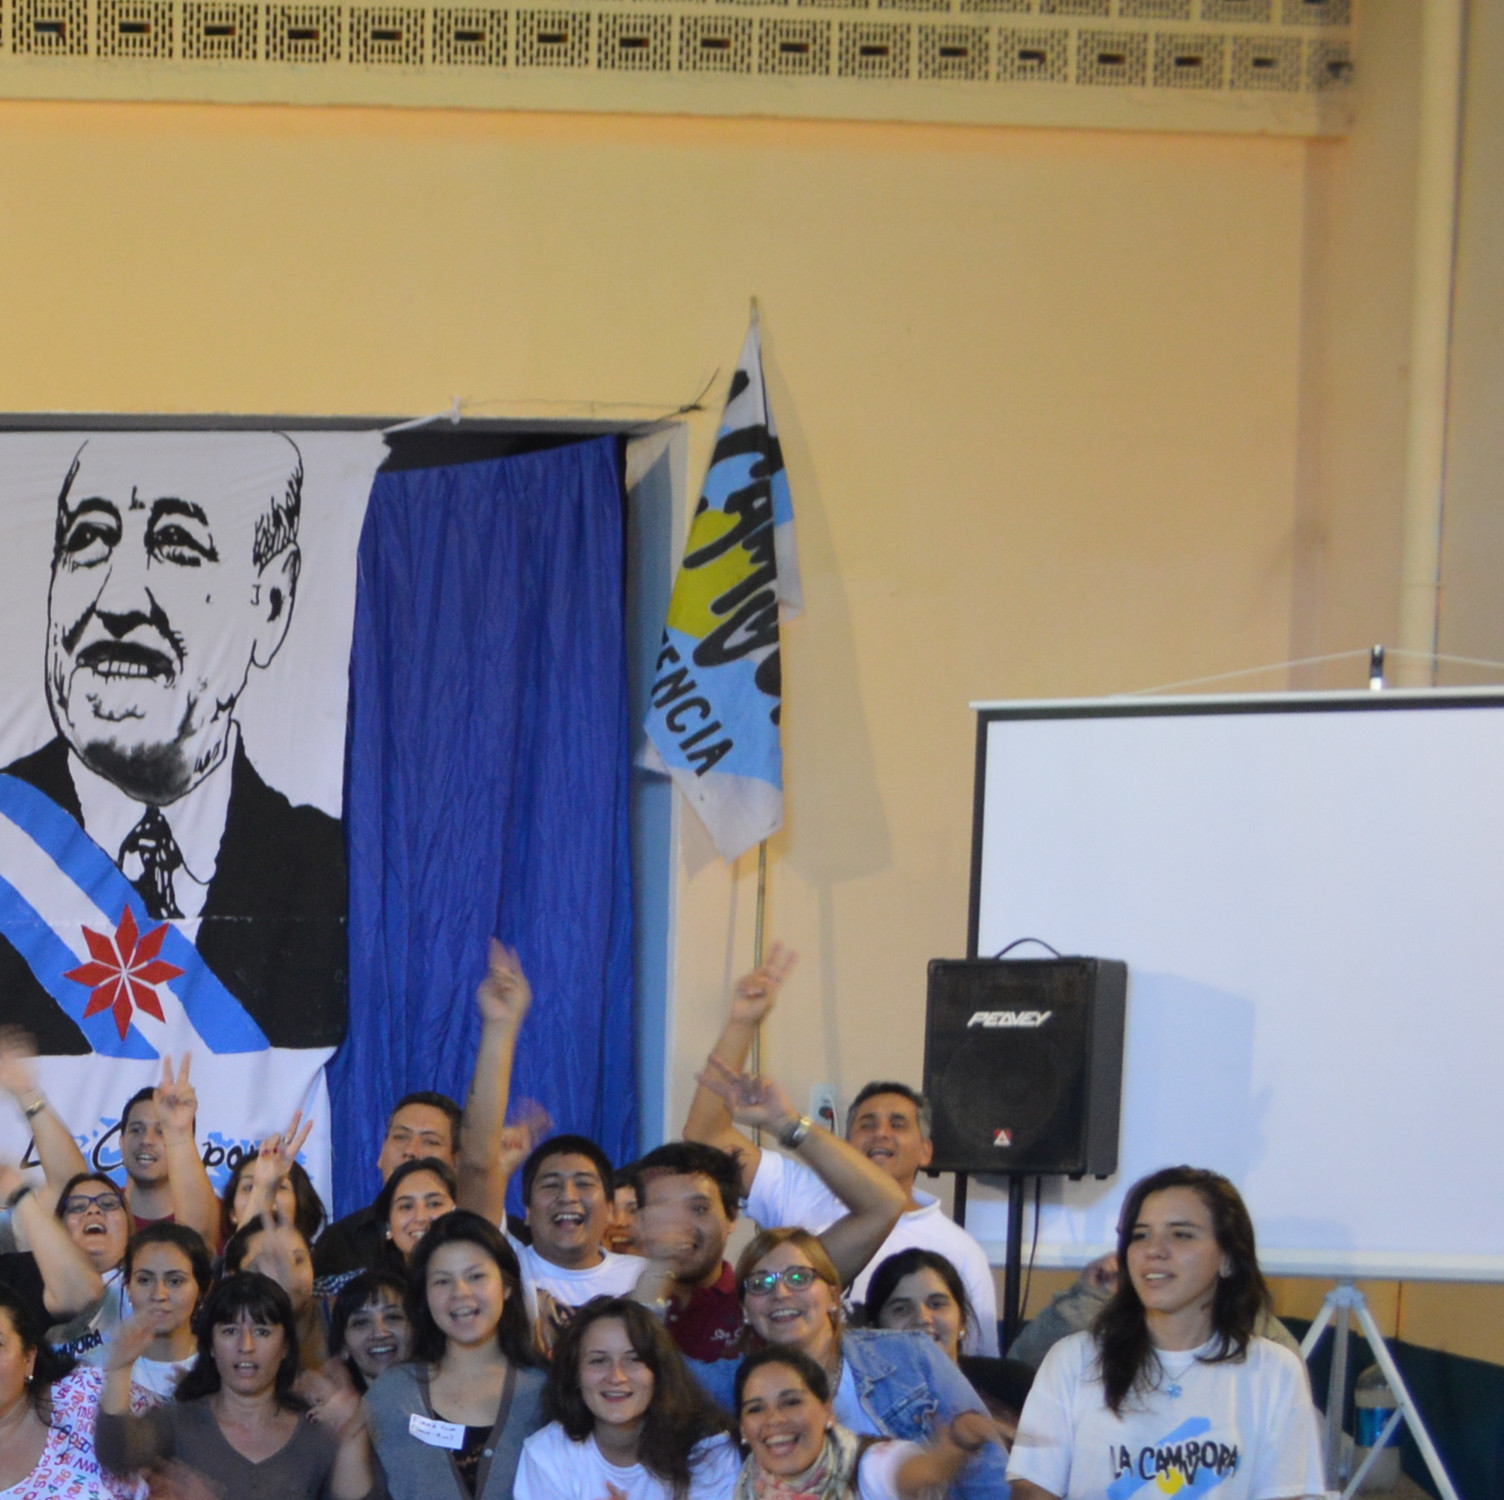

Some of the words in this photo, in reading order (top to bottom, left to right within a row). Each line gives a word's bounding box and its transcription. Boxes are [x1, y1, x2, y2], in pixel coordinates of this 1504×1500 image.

[966, 1010, 1052, 1028] PEAVEY
[1109, 1444, 1134, 1480] LA
[1138, 1440, 1238, 1486] CAMPORA
